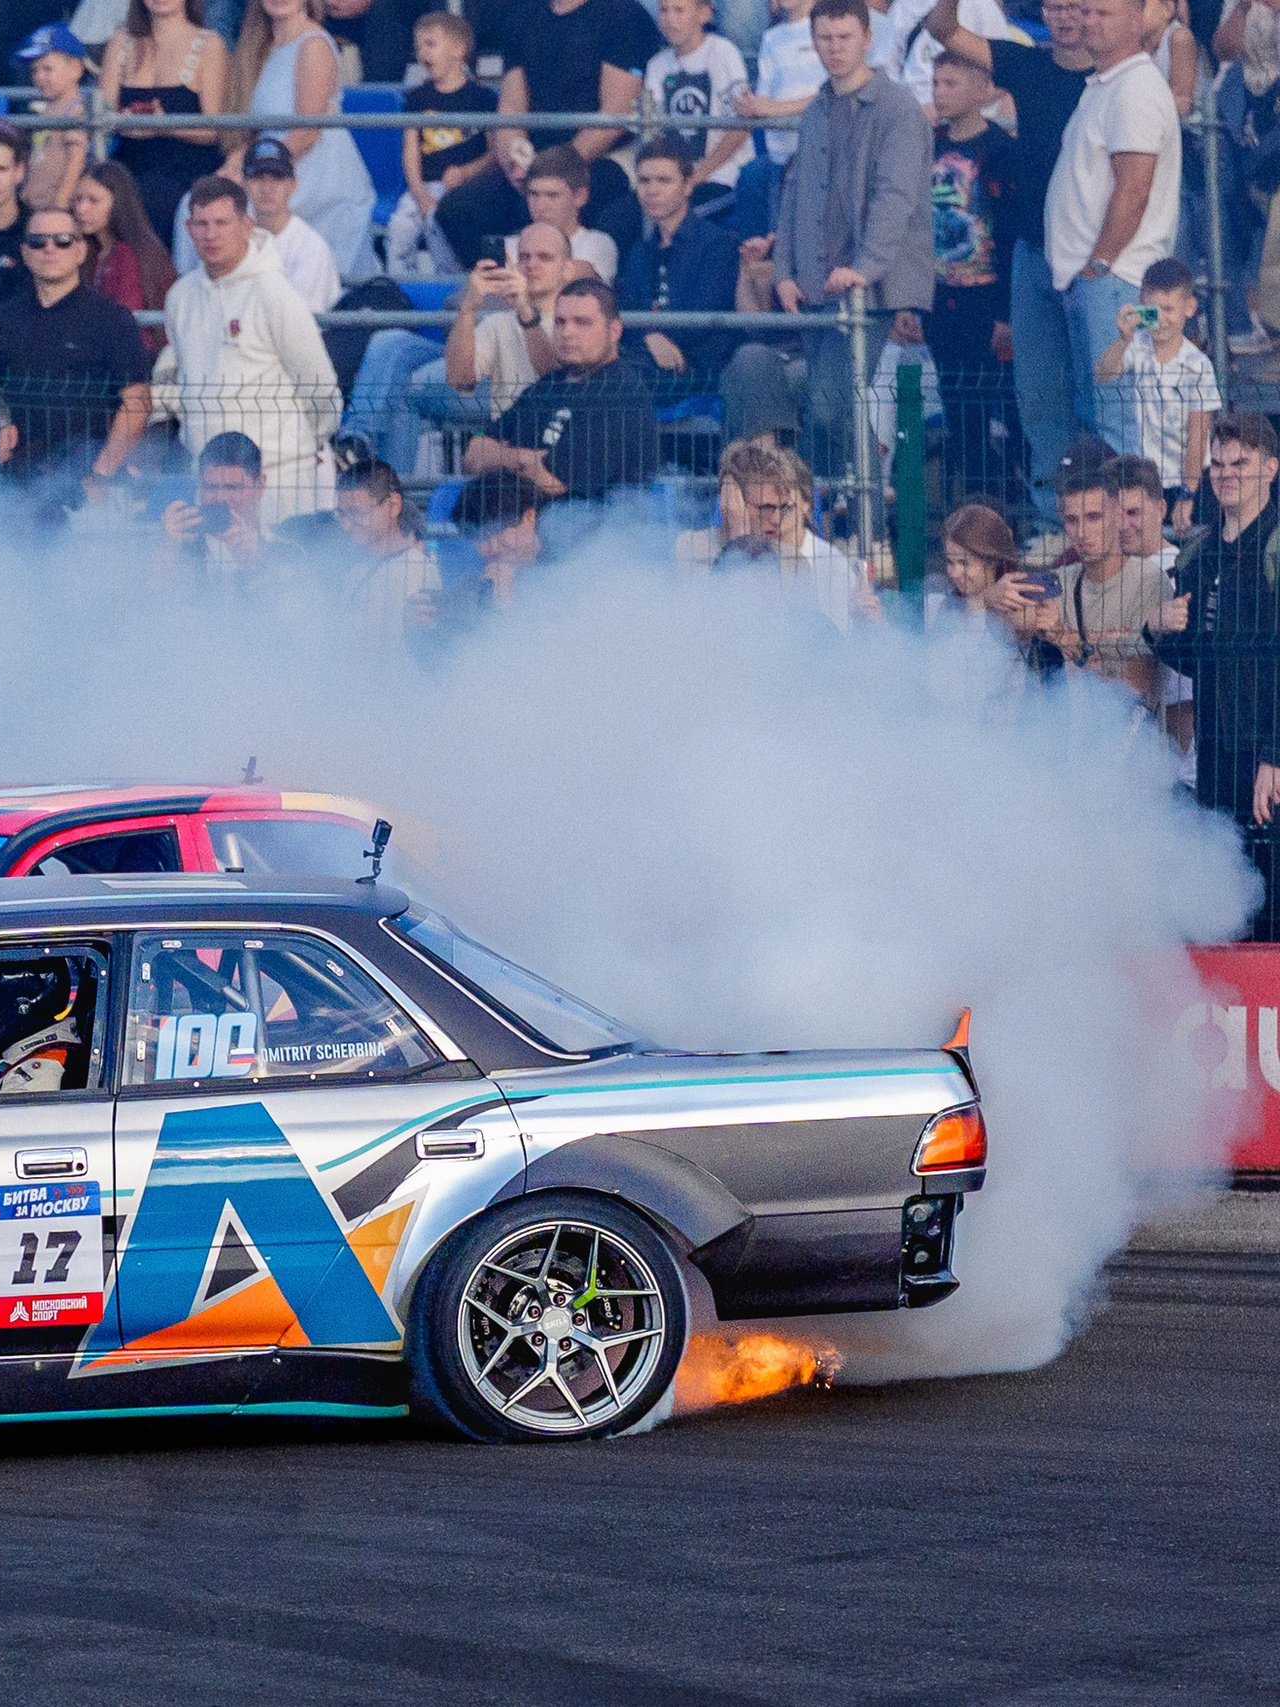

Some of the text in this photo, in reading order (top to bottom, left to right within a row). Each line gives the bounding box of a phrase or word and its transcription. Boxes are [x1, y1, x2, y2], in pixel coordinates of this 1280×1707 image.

[260, 1041, 386, 1063] DMITRIY SCHERBINA
[2, 1187, 47, 1206] БИТВА
[15, 1196, 91, 1218] ЗА МОСКВУ
[11, 1230, 83, 1285] 17
[31, 1296, 88, 1311] МОСКОВСКИЙ
[31, 1310, 58, 1322] СПОРТ
